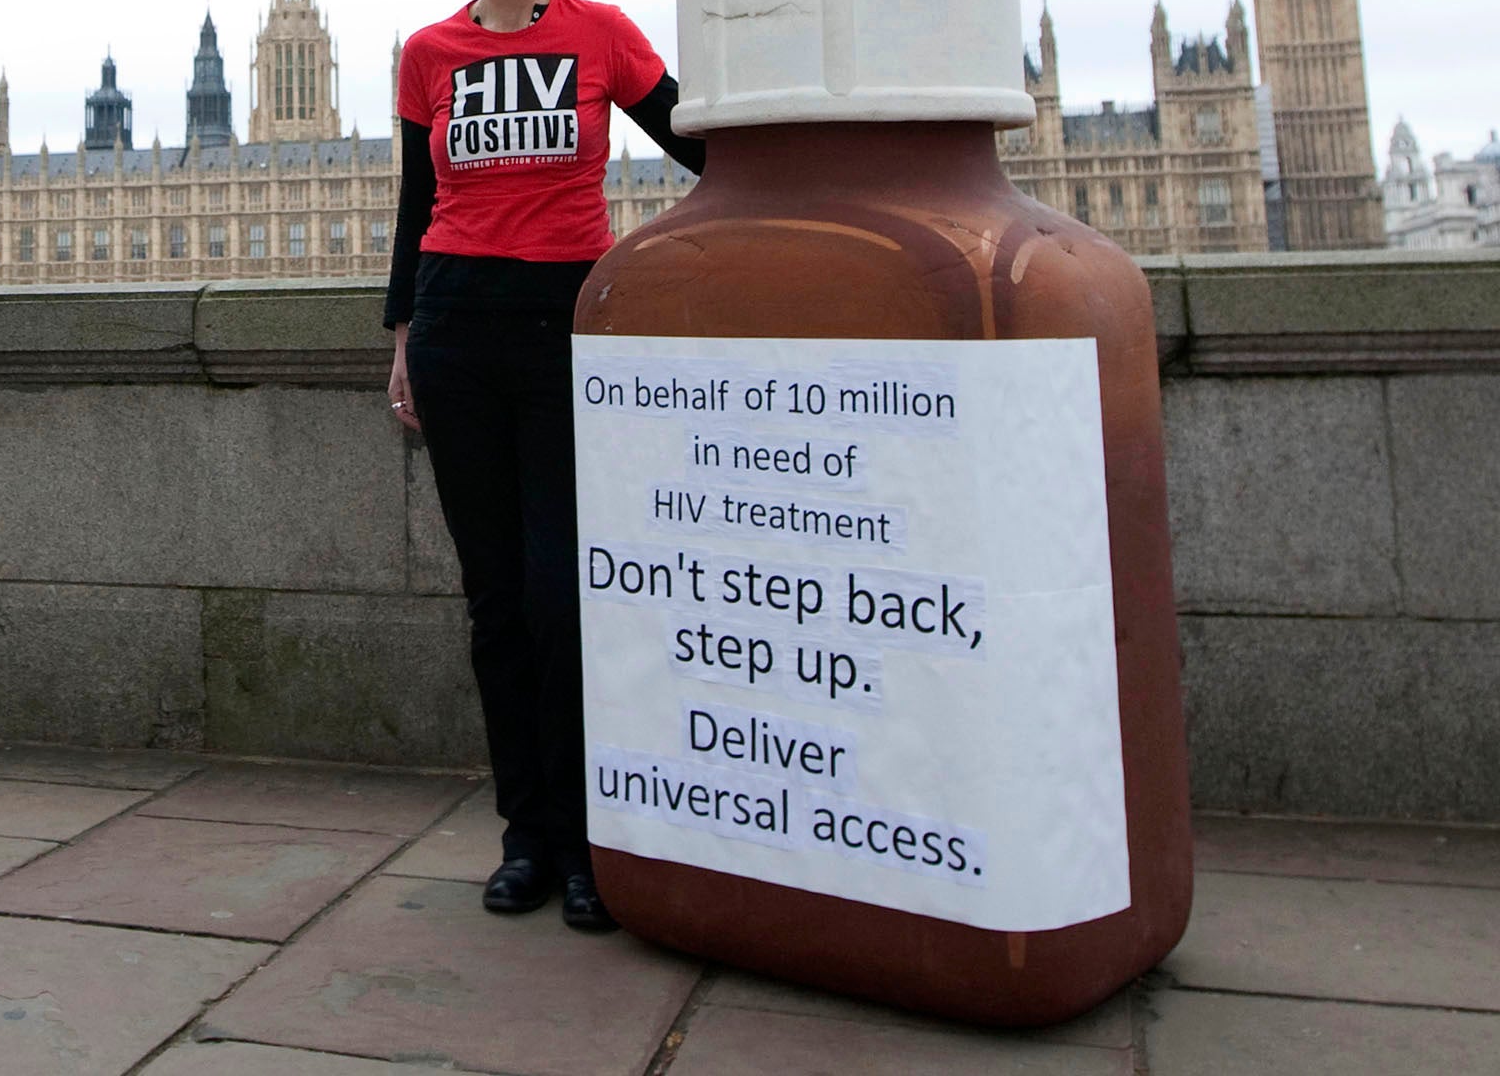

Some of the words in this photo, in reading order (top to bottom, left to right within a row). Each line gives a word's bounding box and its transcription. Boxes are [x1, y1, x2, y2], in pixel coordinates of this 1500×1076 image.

[453, 58, 575, 119] HIV
[449, 114, 575, 157] POSITIVE
[449, 159, 495, 172] TREATMENT
[499, 156, 531, 166] ACTION
[535, 155, 578, 164] CAMPAIGN
[585, 375, 624, 406] On
[635, 377, 730, 412] behalf
[744, 379, 777, 412] of
[787, 382, 826, 416] 10
[839, 380, 955, 419] million
[694, 434, 720, 467] in
[733, 441, 811, 475] need
[823, 444, 858, 479] of
[654, 488, 707, 524] HIV
[722, 494, 891, 544] treatment
[588, 546, 706, 603] Don't
[722, 563, 823, 625] step
[848, 572, 982, 650] back,
[675, 623, 774, 685] step
[797, 646, 872, 700] up.
[689, 709, 846, 778] Deliver
[598, 765, 789, 835] universal
[812, 807, 982, 877] access.
